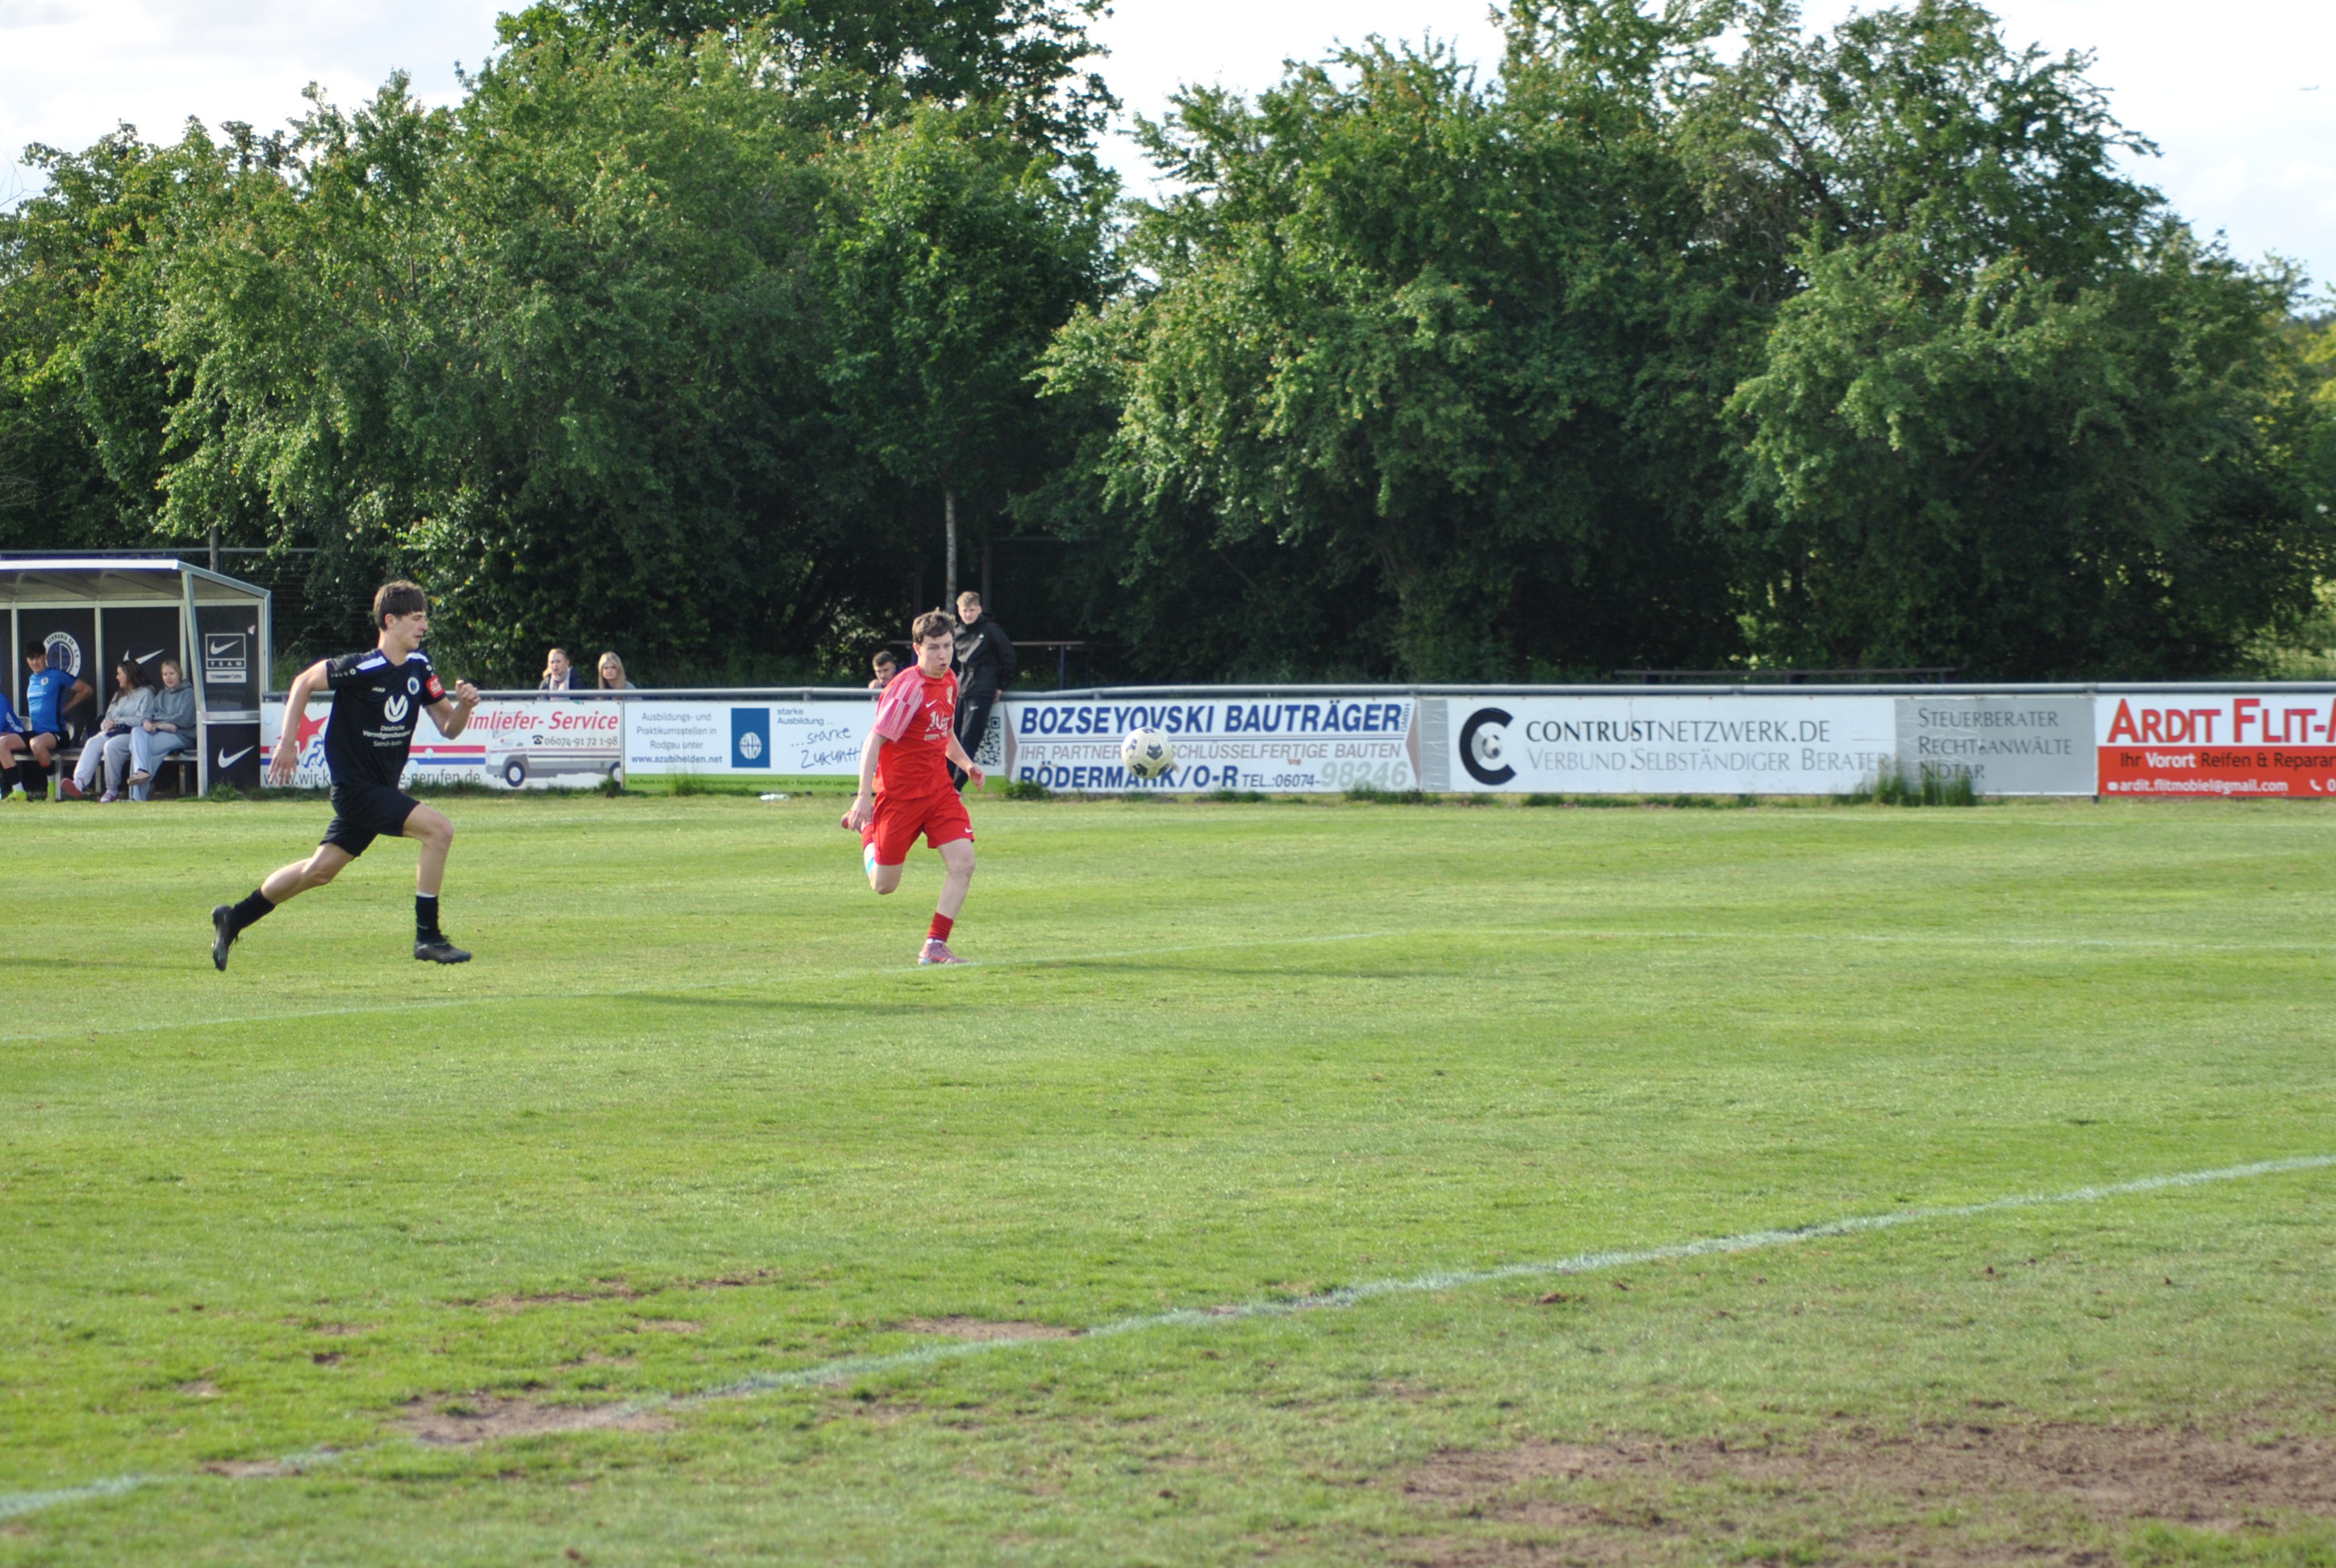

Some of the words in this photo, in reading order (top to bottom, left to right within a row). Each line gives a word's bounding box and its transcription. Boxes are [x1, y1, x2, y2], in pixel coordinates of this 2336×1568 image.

[467, 711, 544, 730] imliefer-
[549, 711, 619, 730] Service
[641, 712, 694, 723] Ausbildungs-
[696, 712, 711, 721] und
[777, 717, 824, 727] Ausbildung
[1020, 705, 1214, 734] BOZSEYOVSKI
[1224, 699, 1402, 732] BAUTRÄGER
[1918, 707, 2059, 728] STEUERBERATER
[2107, 698, 2221, 743] ARDIT
[636, 726, 707, 735] Praktikumsstellen
[709, 726, 717, 735] in
[1525, 720, 1830, 742] CONTRUSTNETZWERK.DE
[544, 736, 585, 748] 06074-91
[649, 740, 680, 751] Rodgau
[682, 741, 703, 749] unter
[1020, 744, 1046, 760] IHR
[1051, 744, 1122, 760] PARTNER
[1334, 743, 1401, 758] BAUTEN
[1918, 735, 2073, 755] RECHTSANWÄLTE
[1526, 748, 1626, 770] VERBUND
[1633, 748, 1790, 771] SELBSTÄNDIGER
[1801, 748, 1890, 771] BERATER
[2121, 753, 2142, 767] Ihr
[2145, 752, 2197, 768] Vorort
[2200, 752, 2251, 767] Reifen
[2257, 752, 2268, 767] &
[1919, 761, 1985, 780] NOTAR
